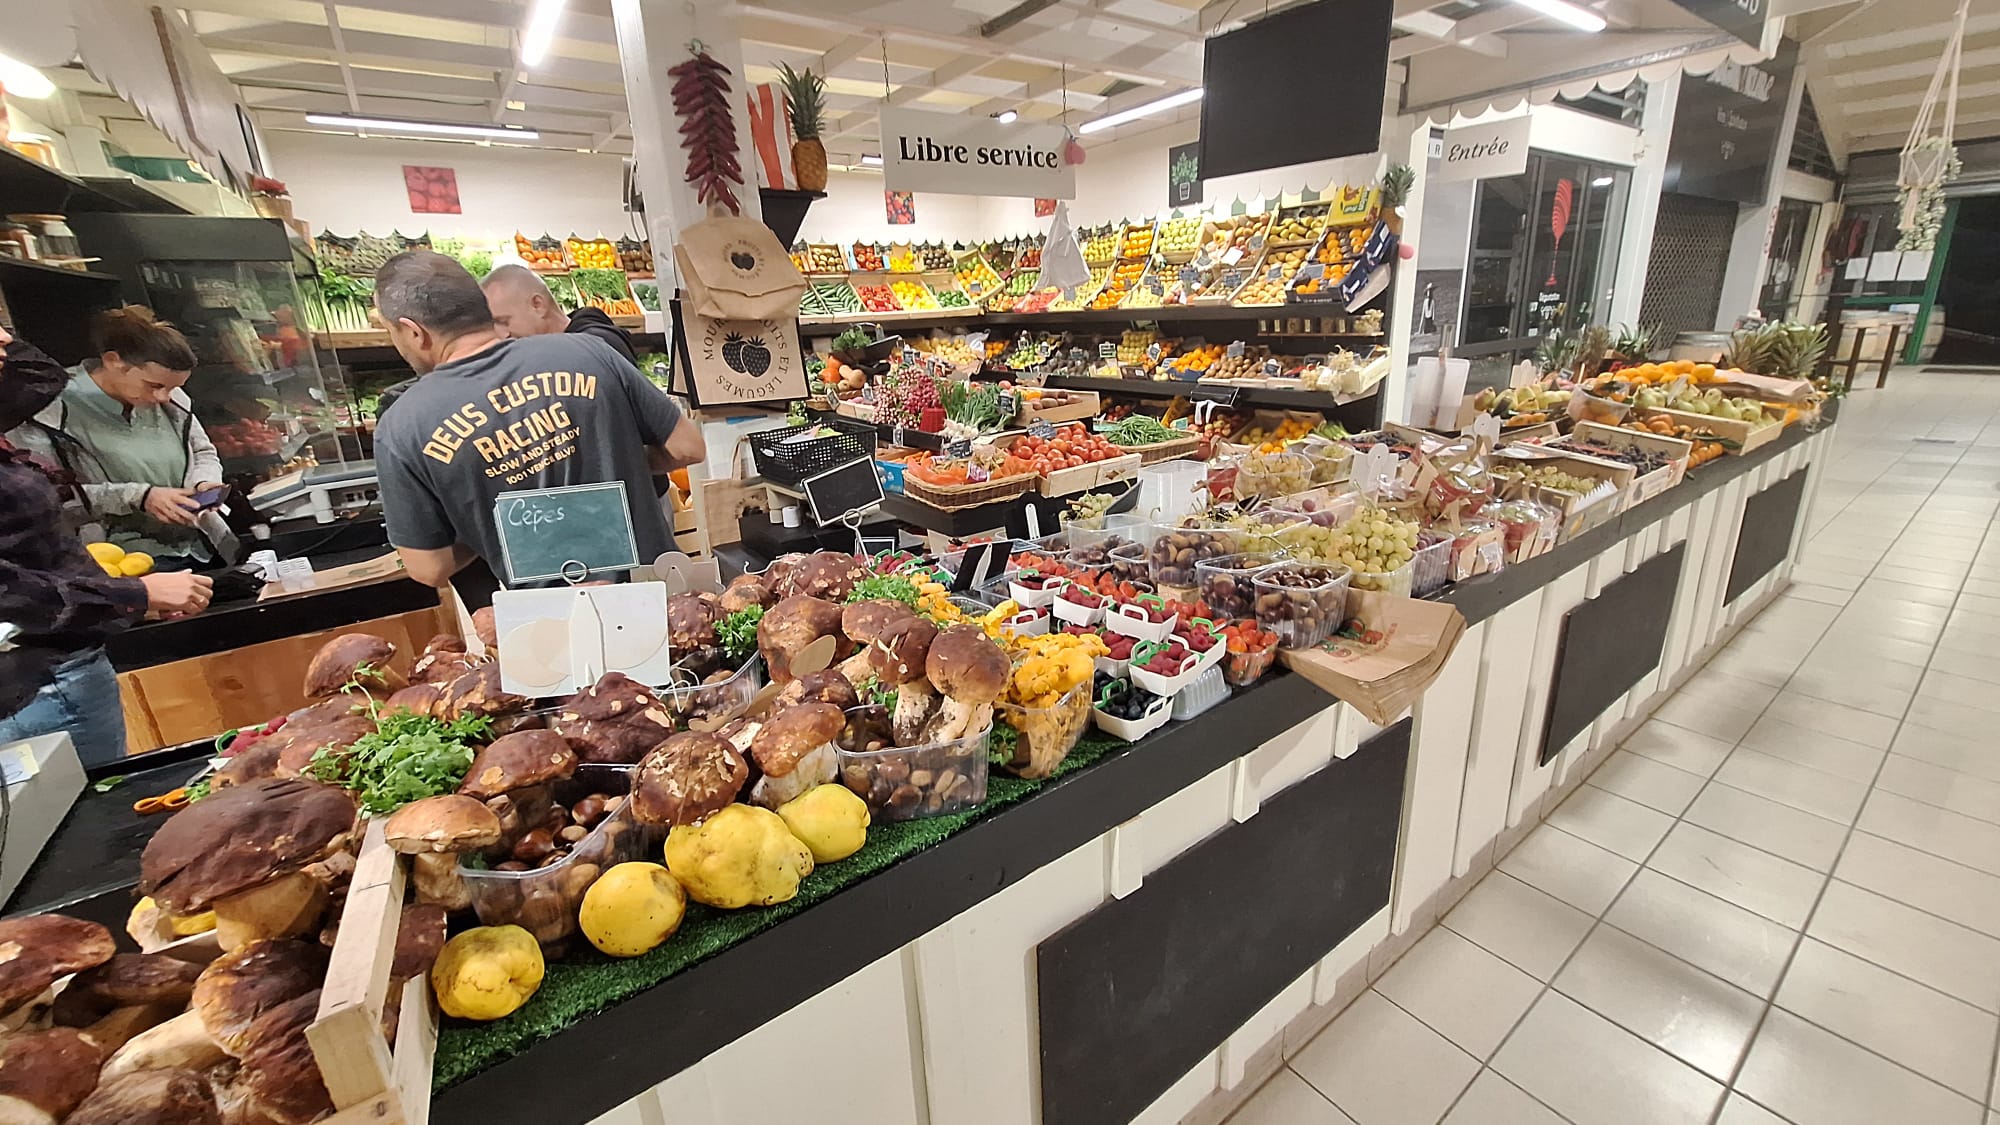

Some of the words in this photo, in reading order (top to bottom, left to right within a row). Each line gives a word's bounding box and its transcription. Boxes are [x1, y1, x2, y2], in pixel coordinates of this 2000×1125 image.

[899, 136, 969, 164] Libre
[976, 144, 1059, 169] service
[1448, 135, 1509, 163] Entrée
[703, 318, 730, 361] MOUR
[779, 356, 790, 375] ET
[715, 375, 783, 399] LÉGUMES
[422, 402, 488, 465] DEUS
[487, 371, 597, 414] CUSTOM
[472, 401, 572, 463] RACING
[484, 458, 520, 478] SLOW
[521, 448, 544, 464] AND
[543, 426, 581, 452] STEADY
[505, 467, 529, 485] 1001
[555, 445, 576, 461] BLVD
